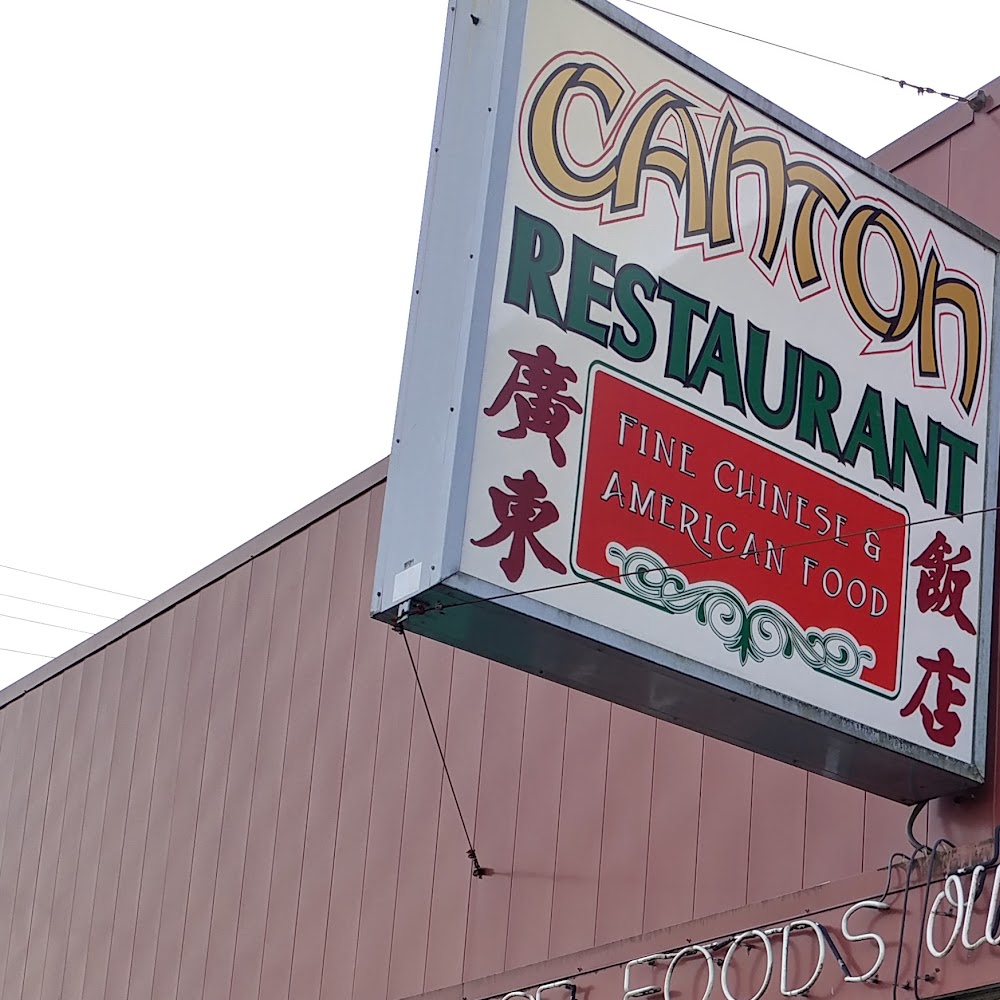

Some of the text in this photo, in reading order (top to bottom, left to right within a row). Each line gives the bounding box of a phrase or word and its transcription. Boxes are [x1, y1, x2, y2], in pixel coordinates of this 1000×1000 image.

[504, 206, 978, 520] RESTAURANT
[600, 471, 888, 617] AMERICAN FOOD
[619, 412, 881, 563] FINE CHINESE &
